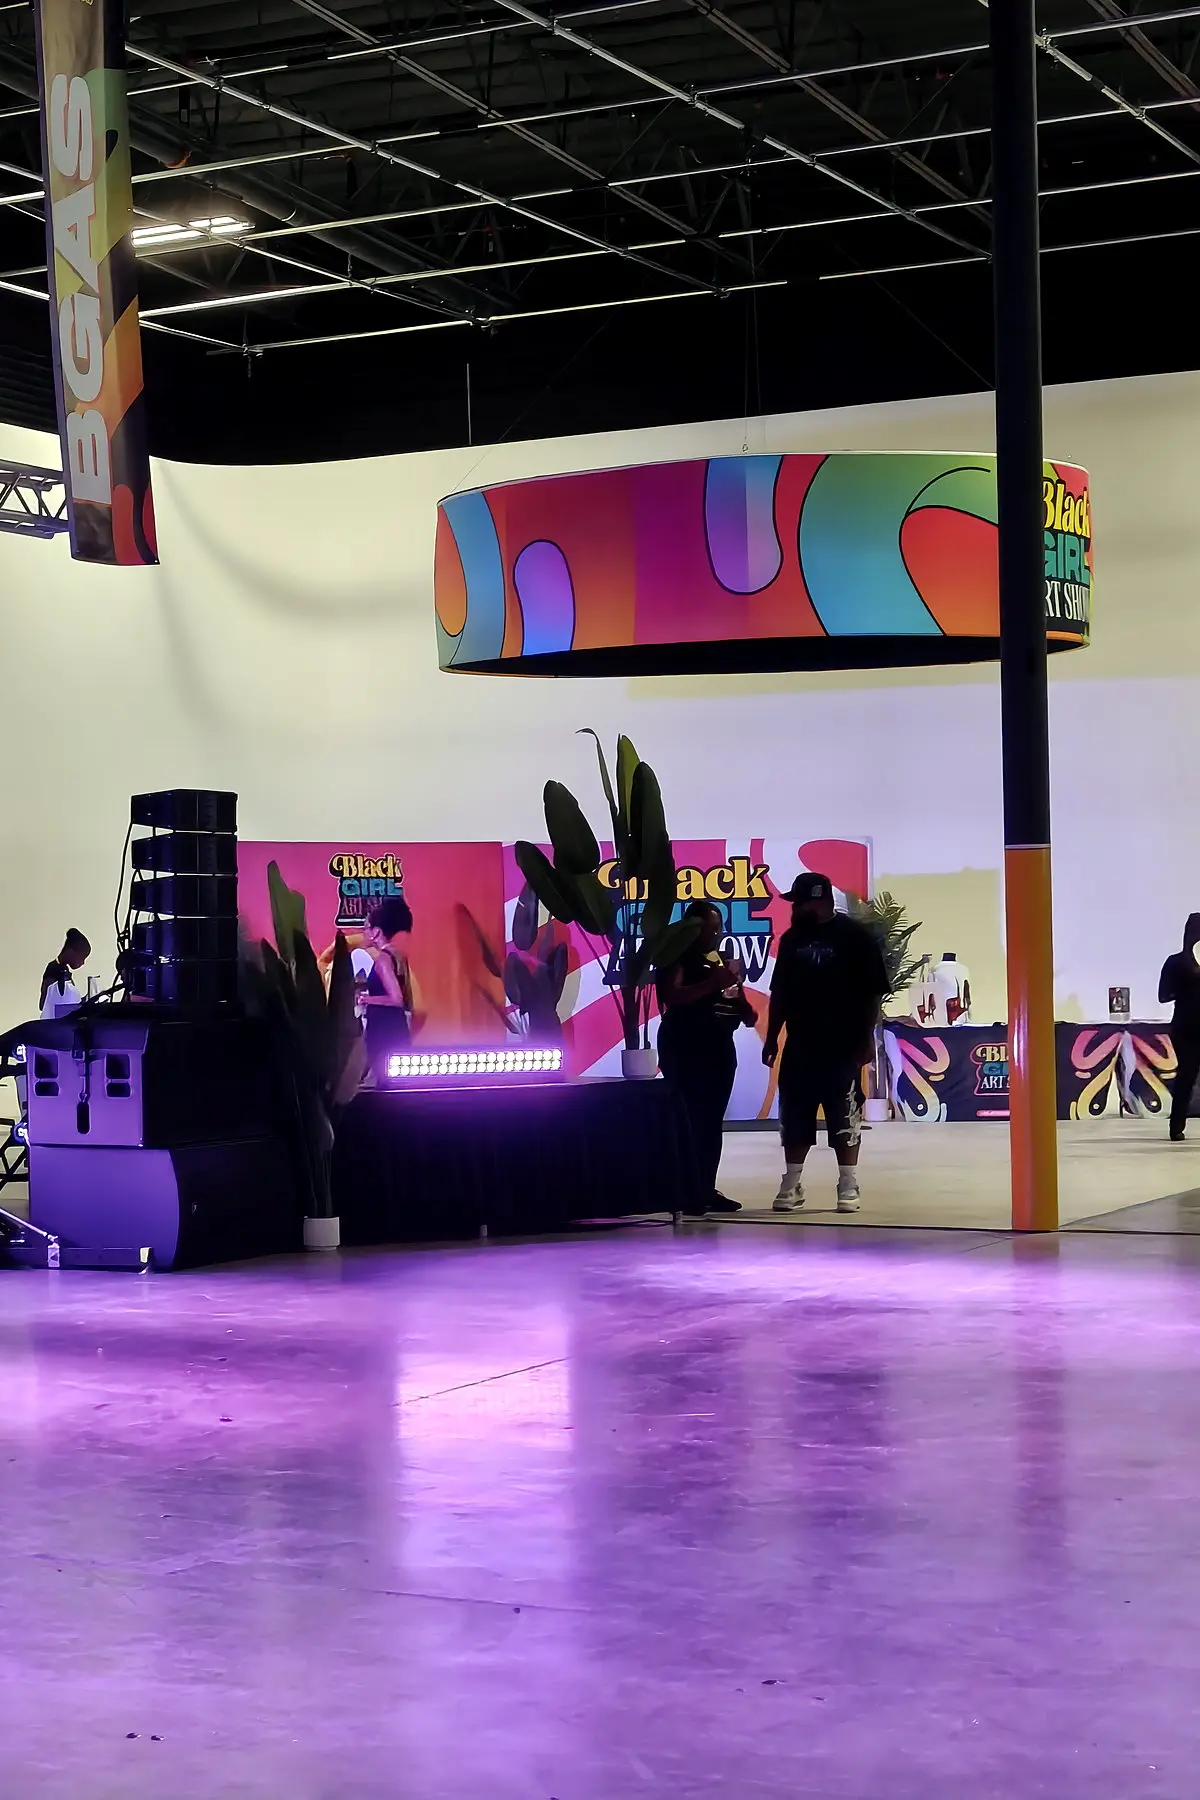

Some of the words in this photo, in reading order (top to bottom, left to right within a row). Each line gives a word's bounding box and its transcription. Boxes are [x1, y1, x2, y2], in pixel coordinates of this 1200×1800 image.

[50, 73, 113, 505] BGAS
[332, 855, 403, 878] Black
[341, 878, 404, 897] GIRL
[981, 1075, 1006, 1089] ART
